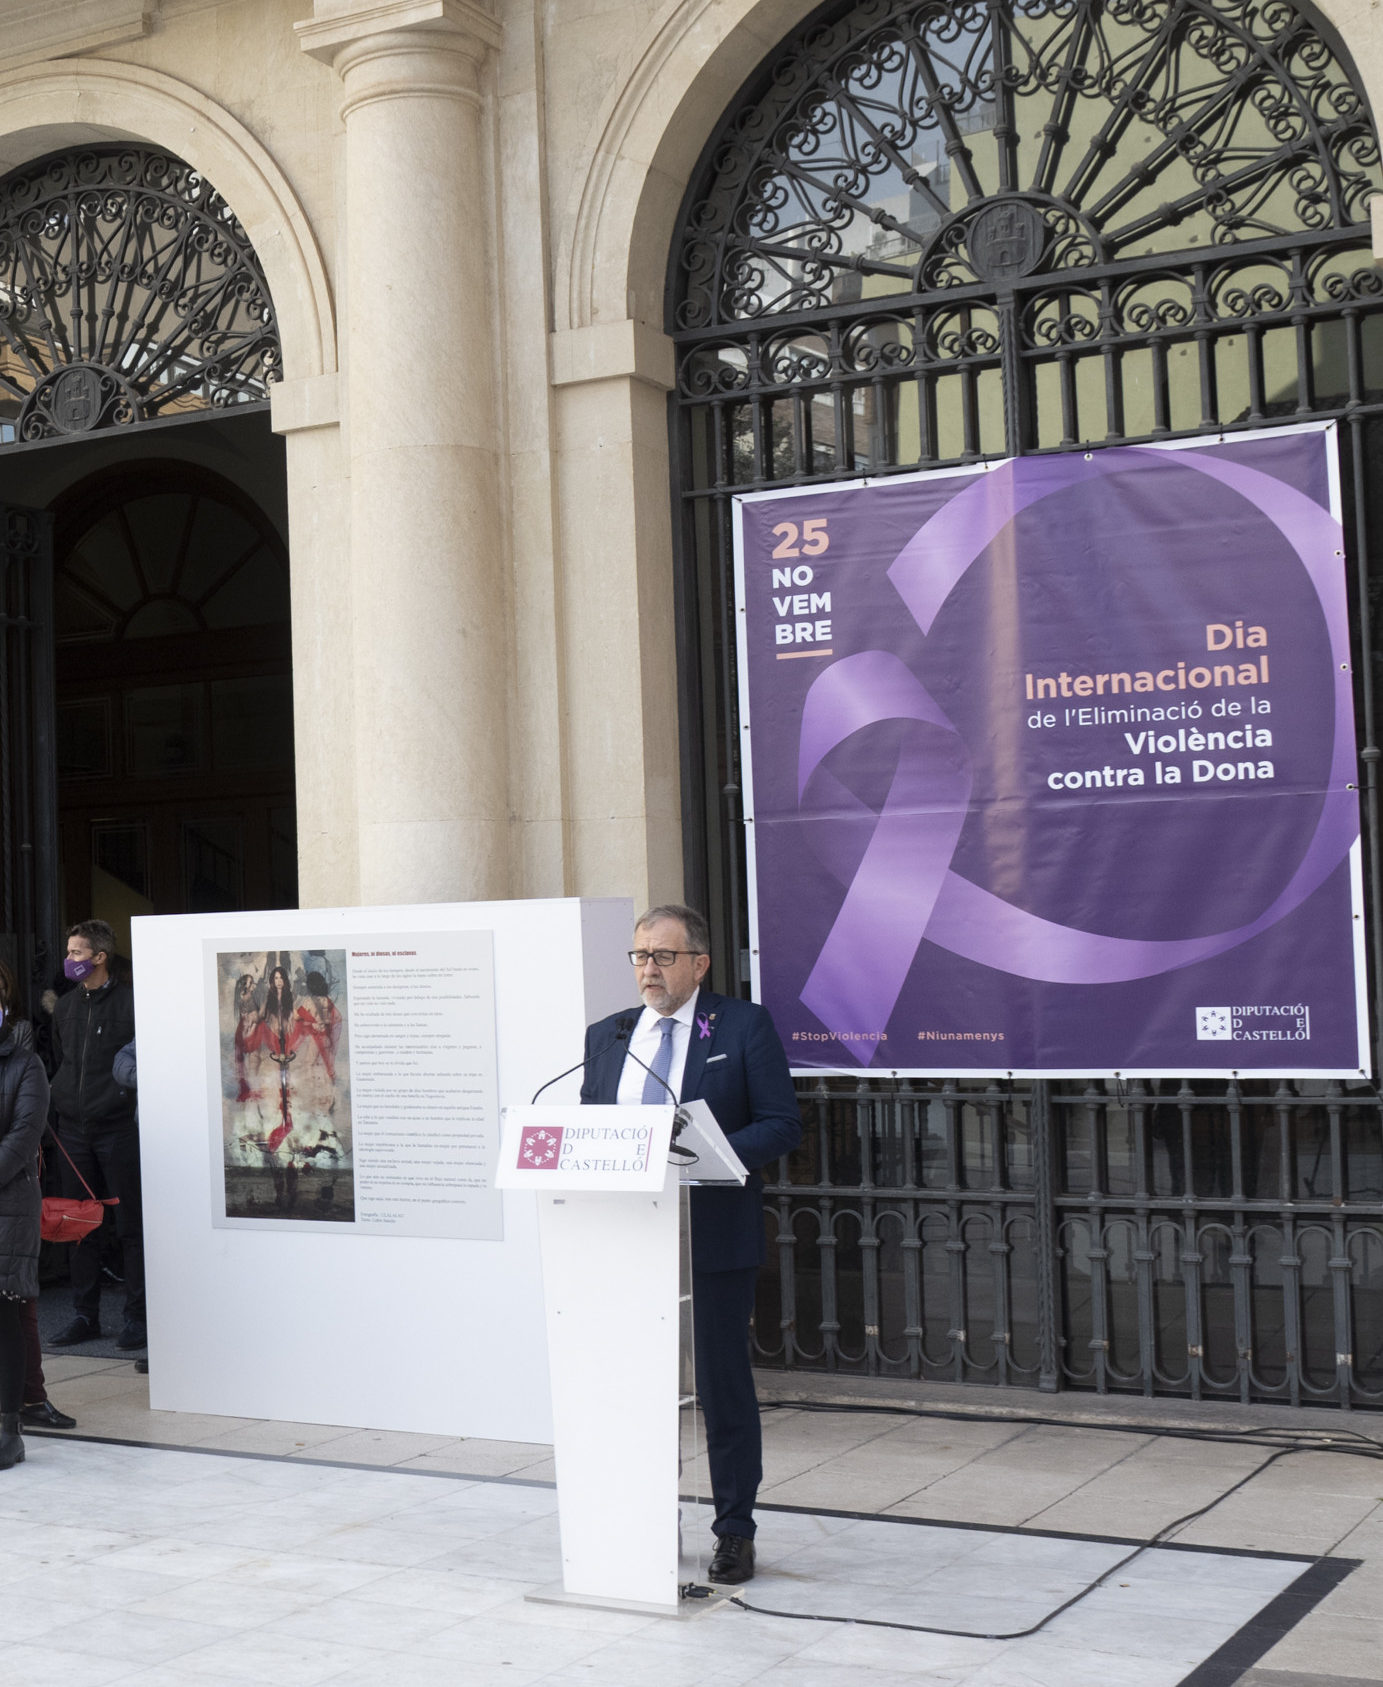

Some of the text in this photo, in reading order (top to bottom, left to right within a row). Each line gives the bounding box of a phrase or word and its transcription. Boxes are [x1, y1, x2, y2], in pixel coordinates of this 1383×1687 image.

[771, 518, 830, 559] 25
[772, 565, 814, 589] NO
[772, 591, 832, 617] VEM
[775, 619, 833, 645] BRE
[1205, 620, 1268, 651] Dia
[1025, 655, 1270, 700] Internacional
[1027, 696, 1271, 729] de l'Eliminació de la
[1124, 724, 1272, 755] Violència
[1047, 760, 1275, 790] contra la Dona
[1232, 1003, 1305, 1016] DIPUTACIÓ
[792, 1031, 1005, 1042] #StopViolencia #Niunamenys
[1232, 1028, 1306, 1041] CASTELLÓ
[565, 1125, 648, 1140] DIPUTACIÓ
[559, 1156, 643, 1171] CASTELLÓ
